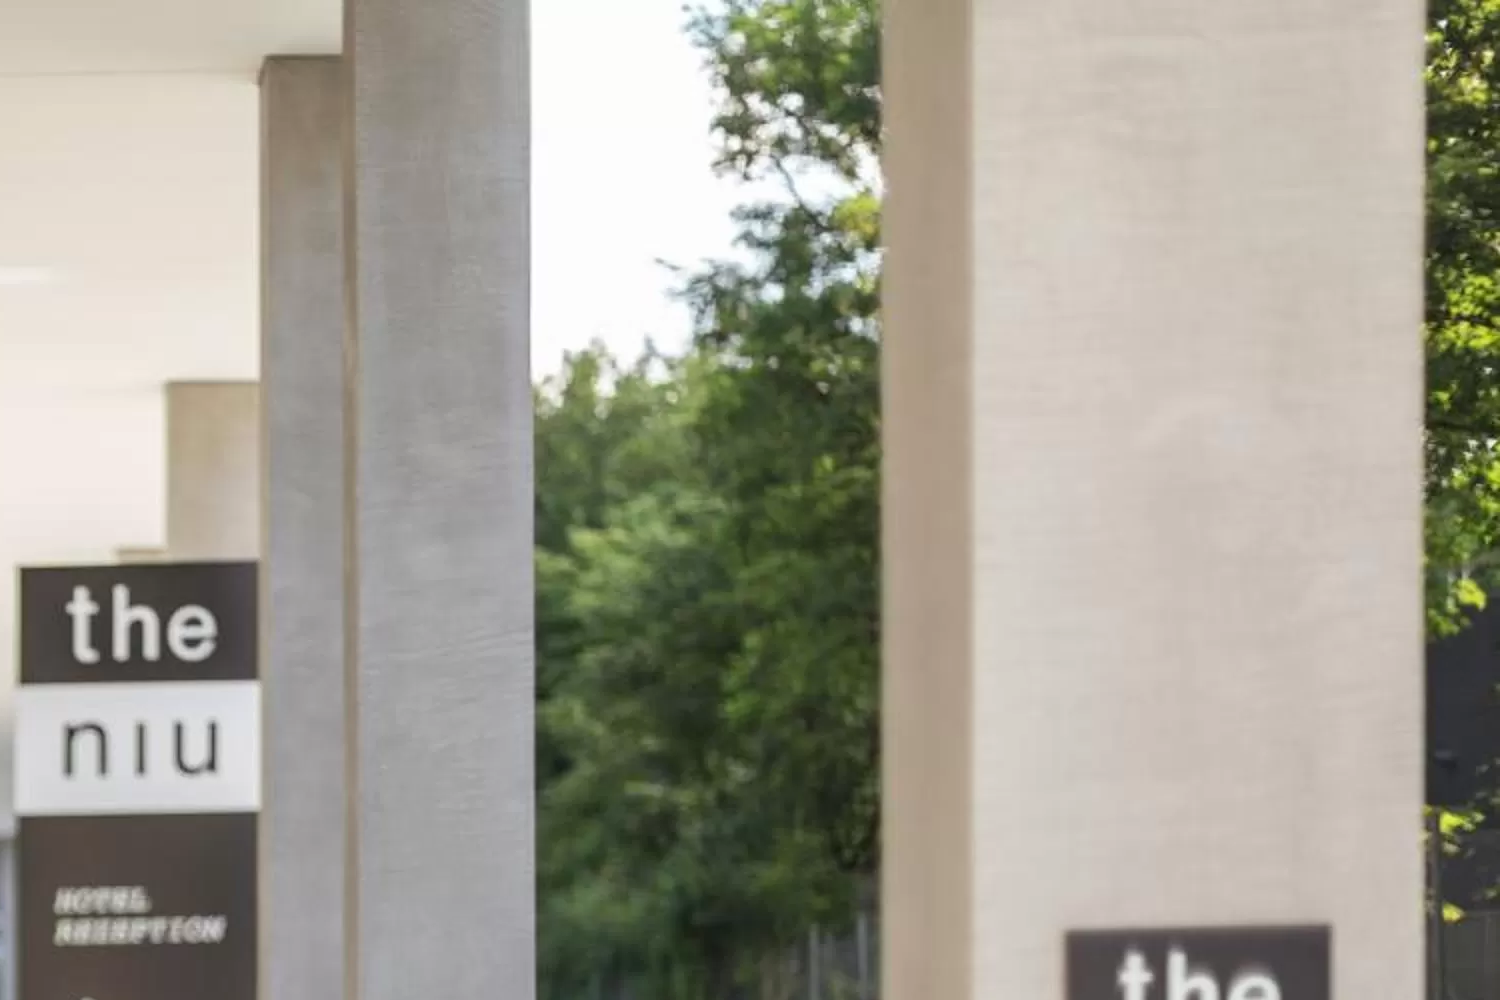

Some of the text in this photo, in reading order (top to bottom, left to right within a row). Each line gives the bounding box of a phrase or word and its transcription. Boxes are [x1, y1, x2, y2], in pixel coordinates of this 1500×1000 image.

[66, 584, 218, 663] the
[63, 721, 218, 777] niu
[54, 886, 151, 915] HOTEL
